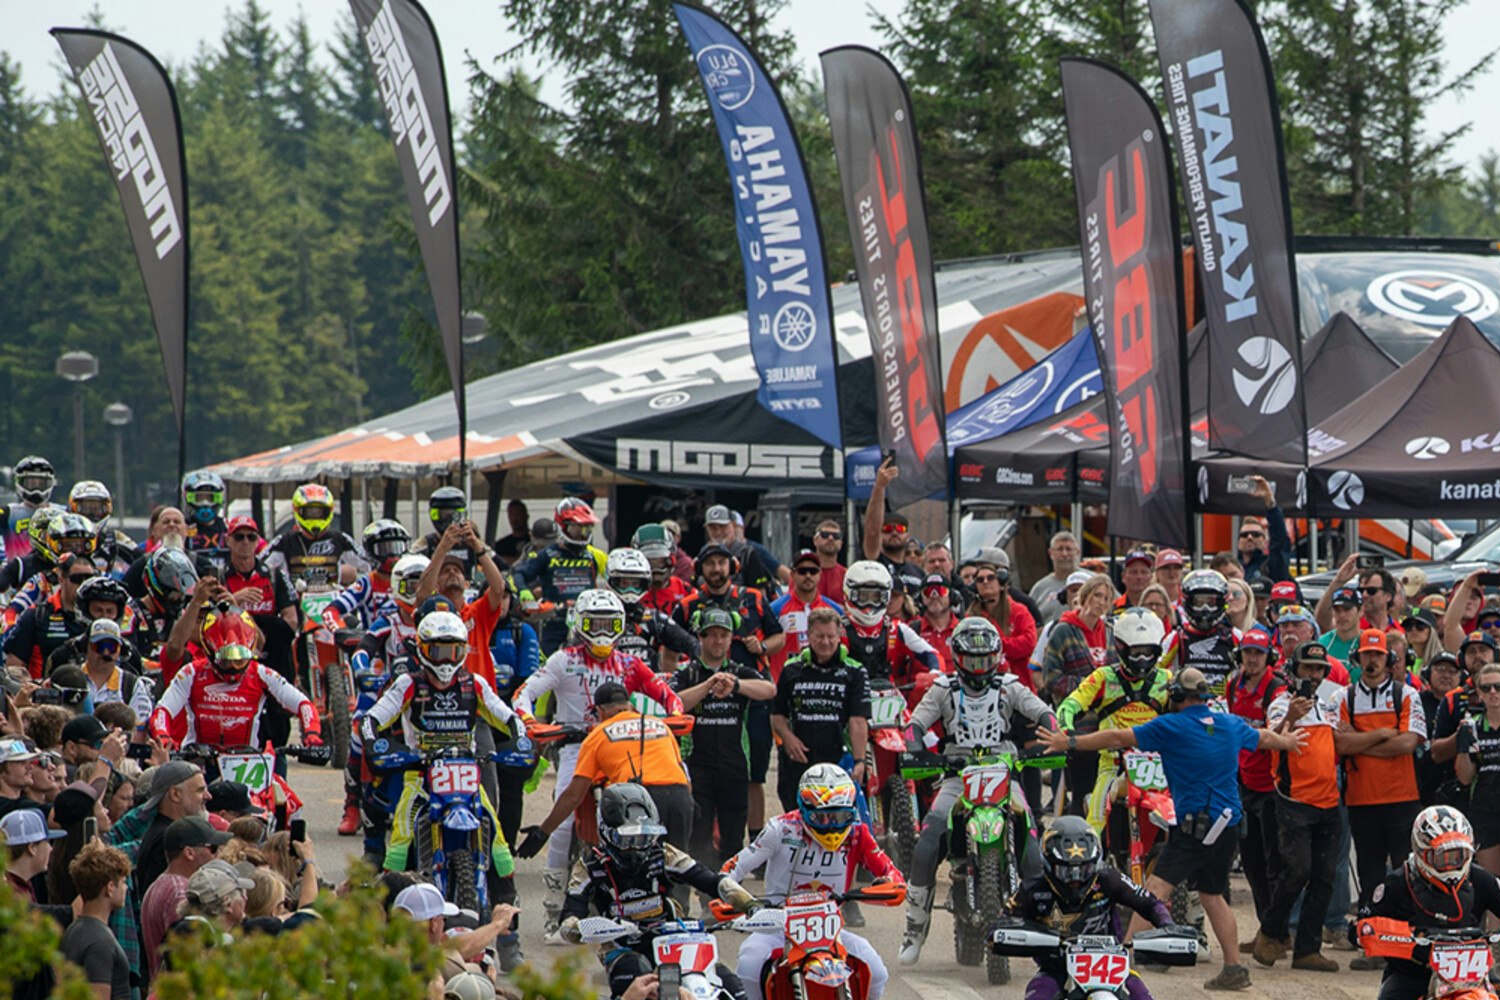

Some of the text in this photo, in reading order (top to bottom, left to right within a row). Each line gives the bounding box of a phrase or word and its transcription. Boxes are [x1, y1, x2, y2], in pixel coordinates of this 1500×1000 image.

[616, 438, 826, 479] MOOSE
[203, 695, 247, 703] HONDA
[436, 720, 468, 730] YAMAHA
[232, 762, 266, 789] 14
[430, 766, 480, 794] 212
[966, 770, 1008, 801] 17
[788, 914, 842, 945] 530
[675, 943, 699, 971] 1
[1075, 954, 1127, 985] 342
[1438, 951, 1489, 980] 514
